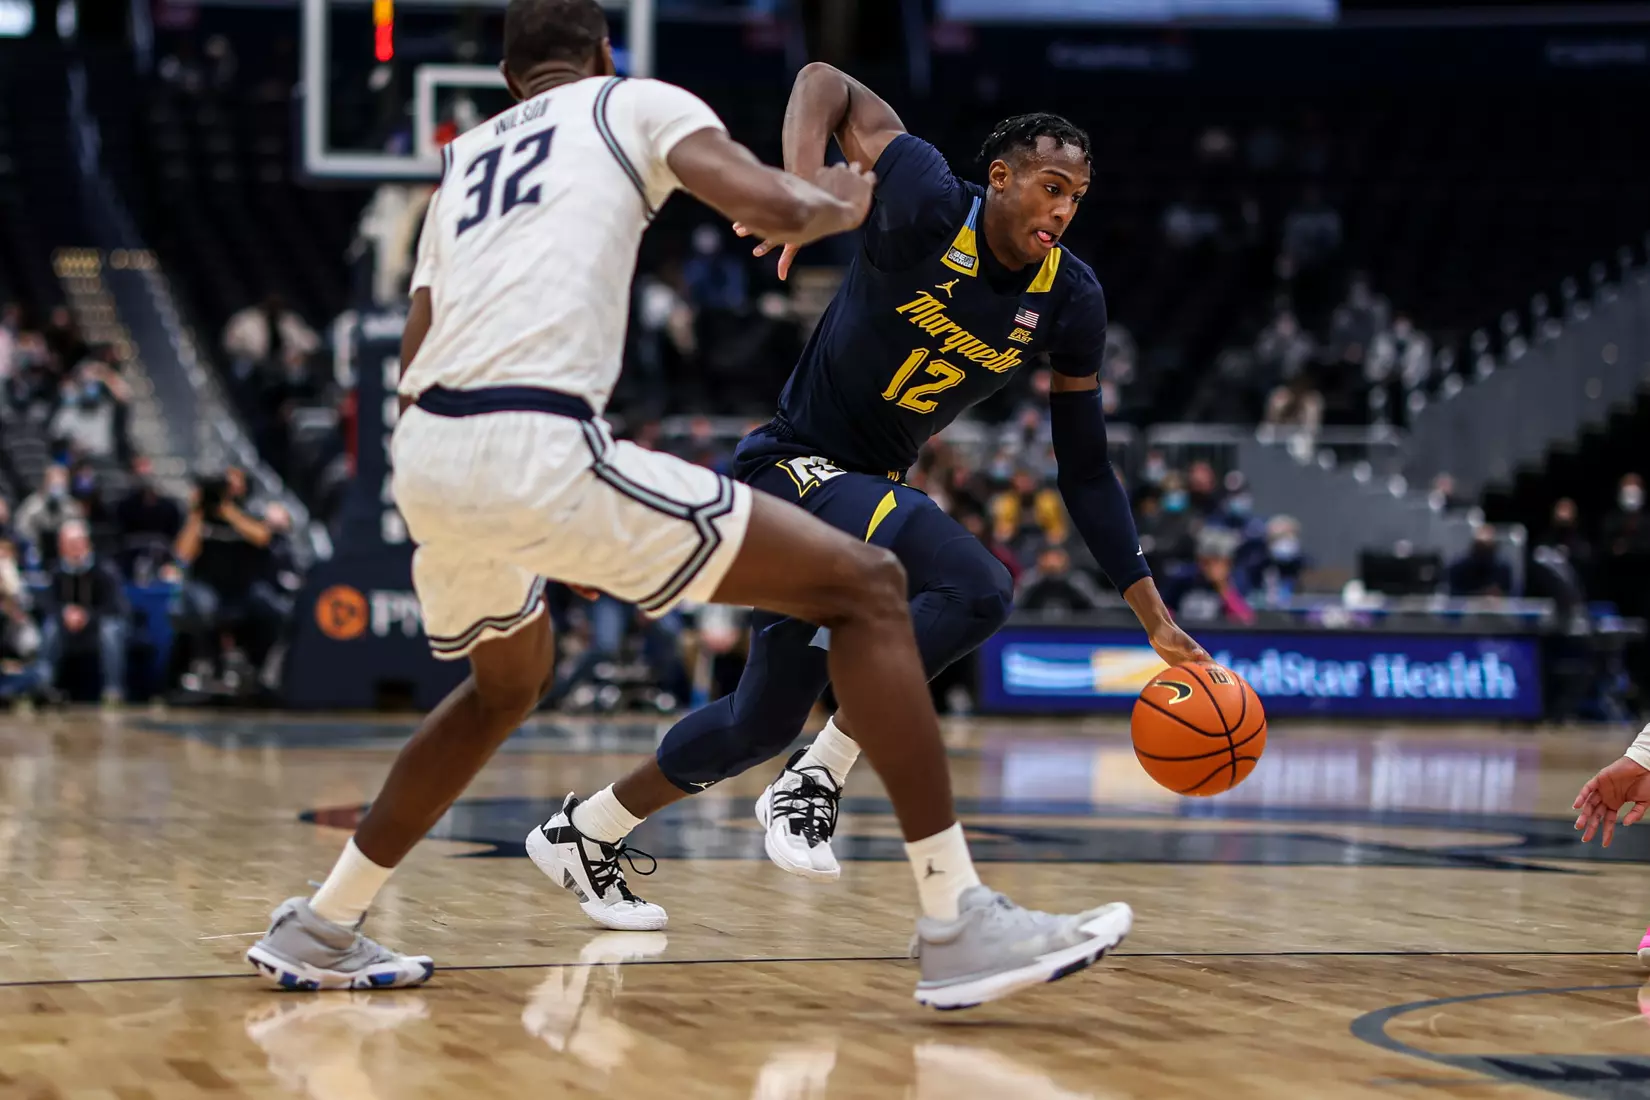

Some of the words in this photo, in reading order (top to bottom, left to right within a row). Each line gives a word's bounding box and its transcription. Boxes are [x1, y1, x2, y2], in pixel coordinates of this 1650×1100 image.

[456, 125, 557, 238] 32
[895, 290, 1023, 374] Marquette
[1008, 332, 1034, 345] EAST
[1013, 327, 1032, 338] BIG
[881, 347, 966, 414] 12
[1372, 651, 1517, 699] Health
